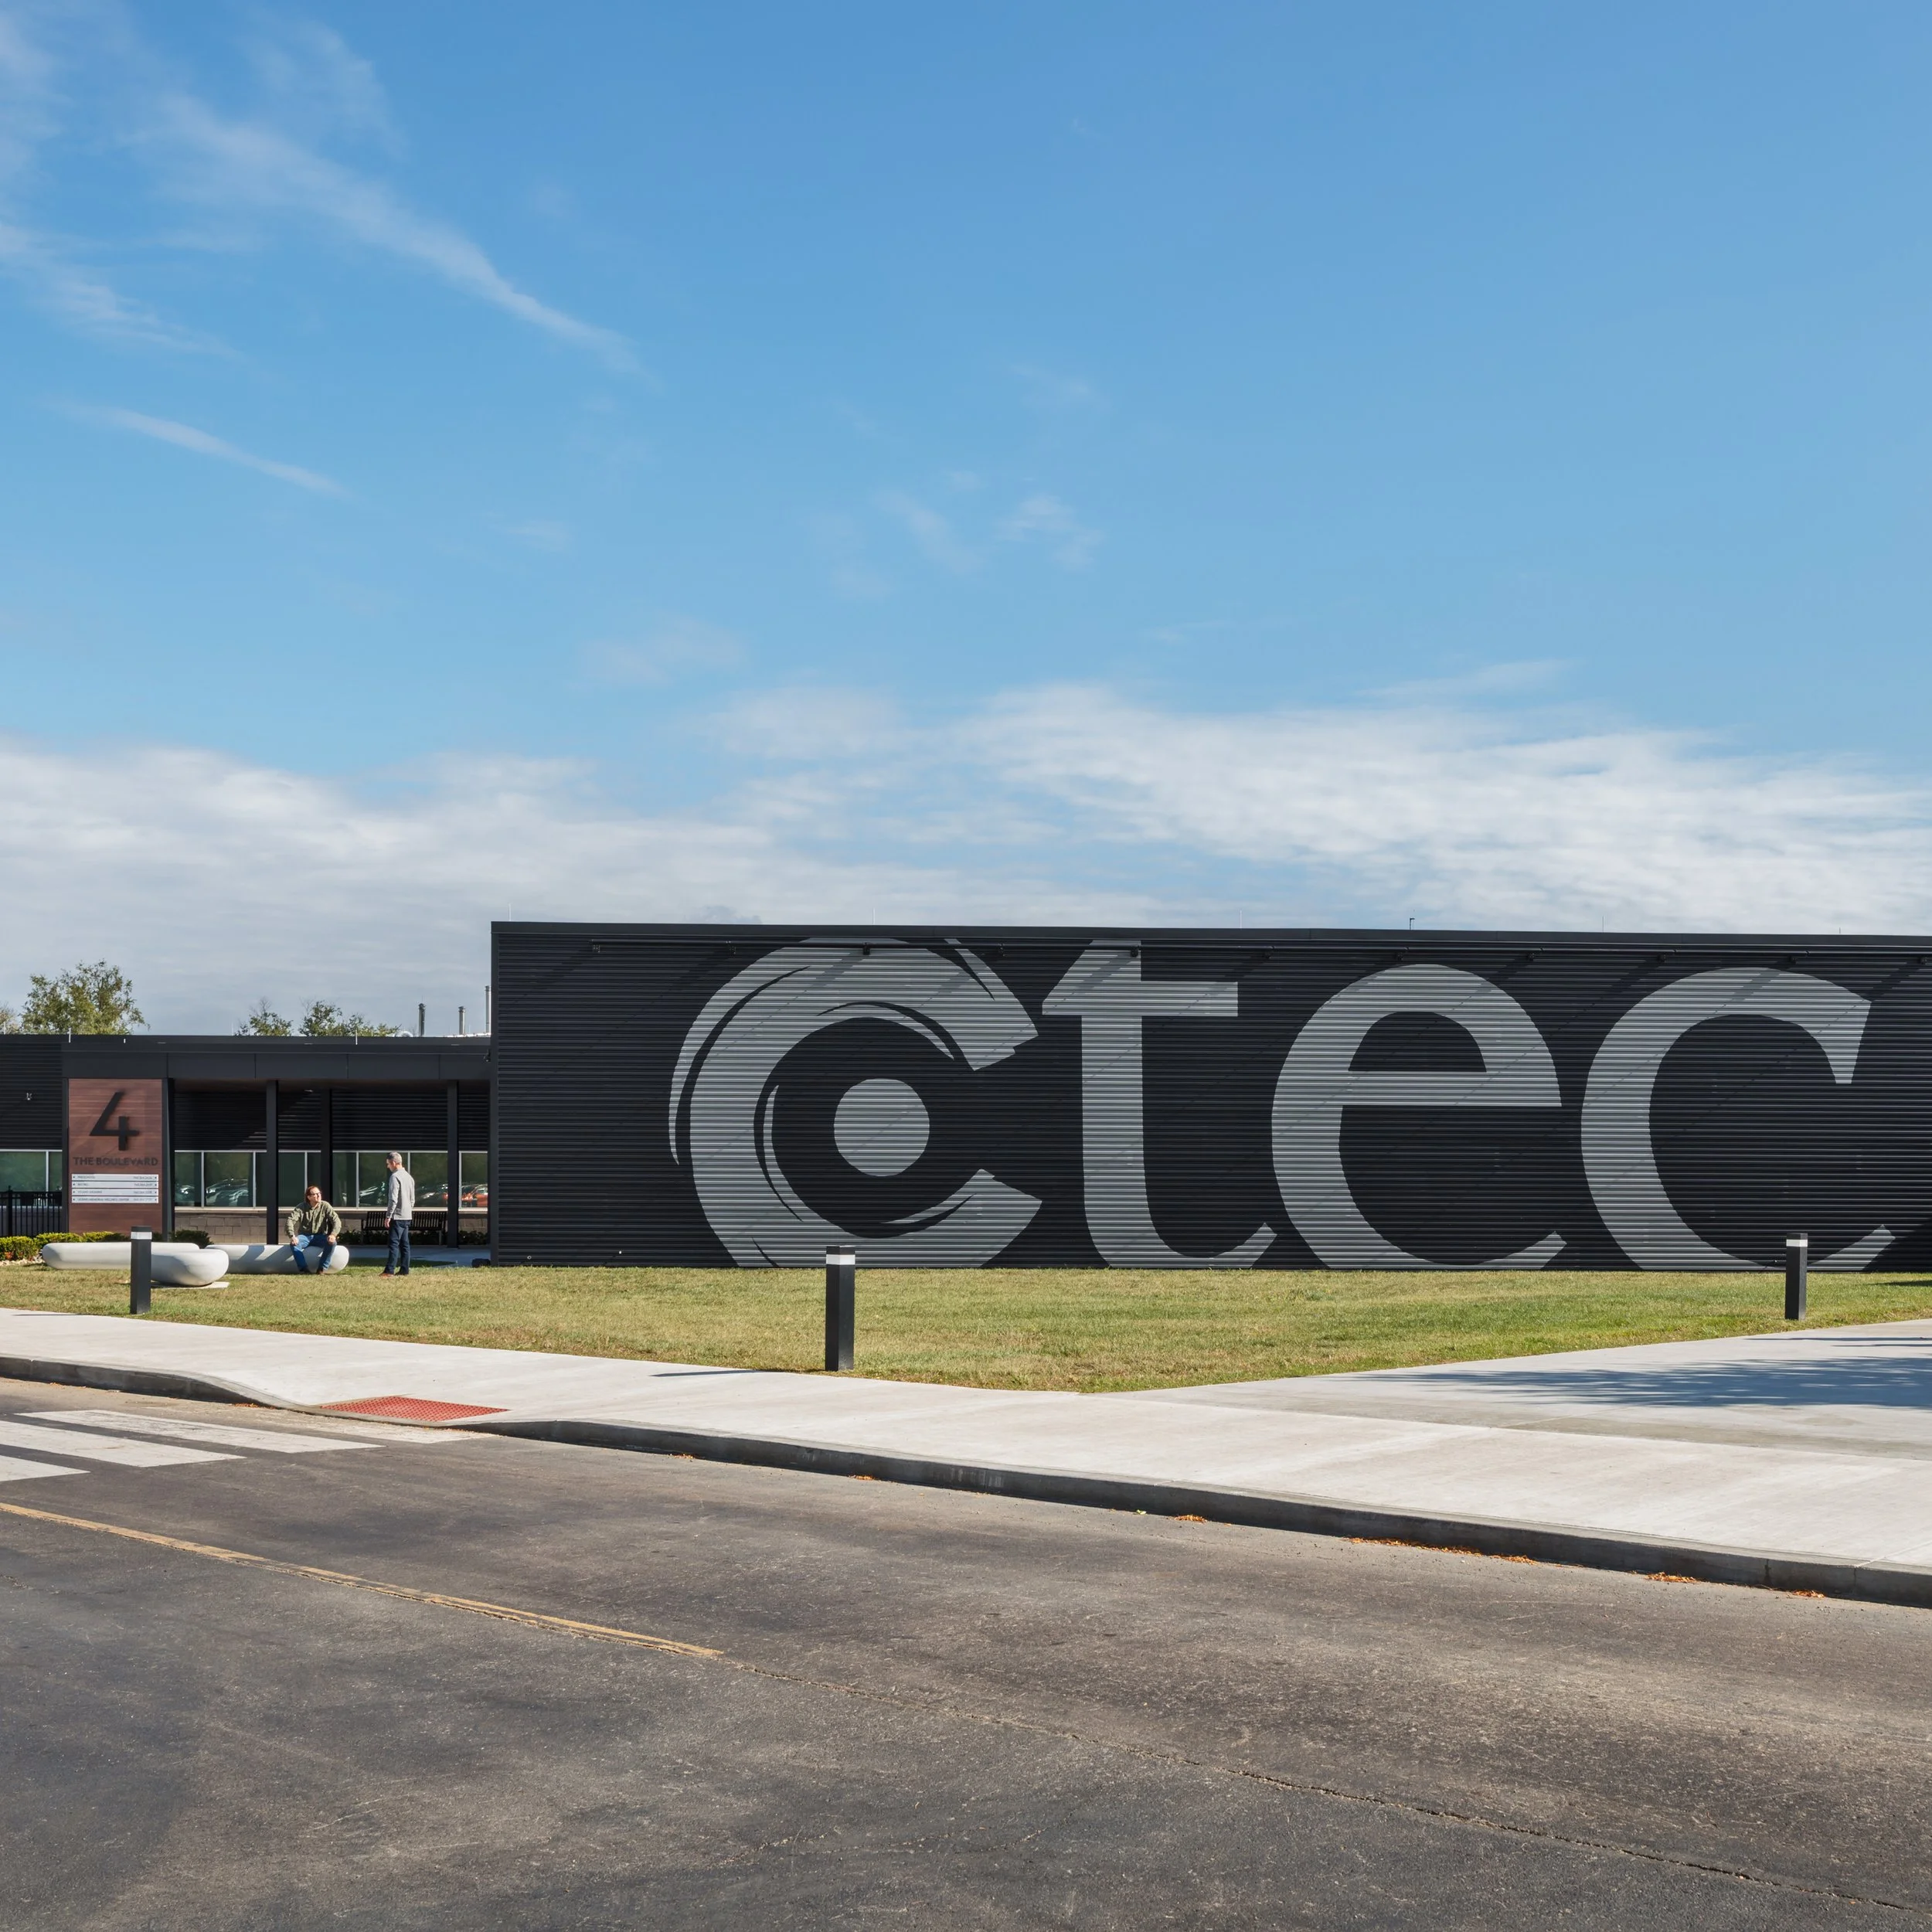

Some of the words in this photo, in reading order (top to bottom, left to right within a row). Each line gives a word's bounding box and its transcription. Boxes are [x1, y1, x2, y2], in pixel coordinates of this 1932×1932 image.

[89, 1090, 140, 1151] 4
[668, 937, 1896, 1270] ctec
[73, 1157, 94, 1166] THE
[97, 1157, 158, 1166] BOULEVARD
